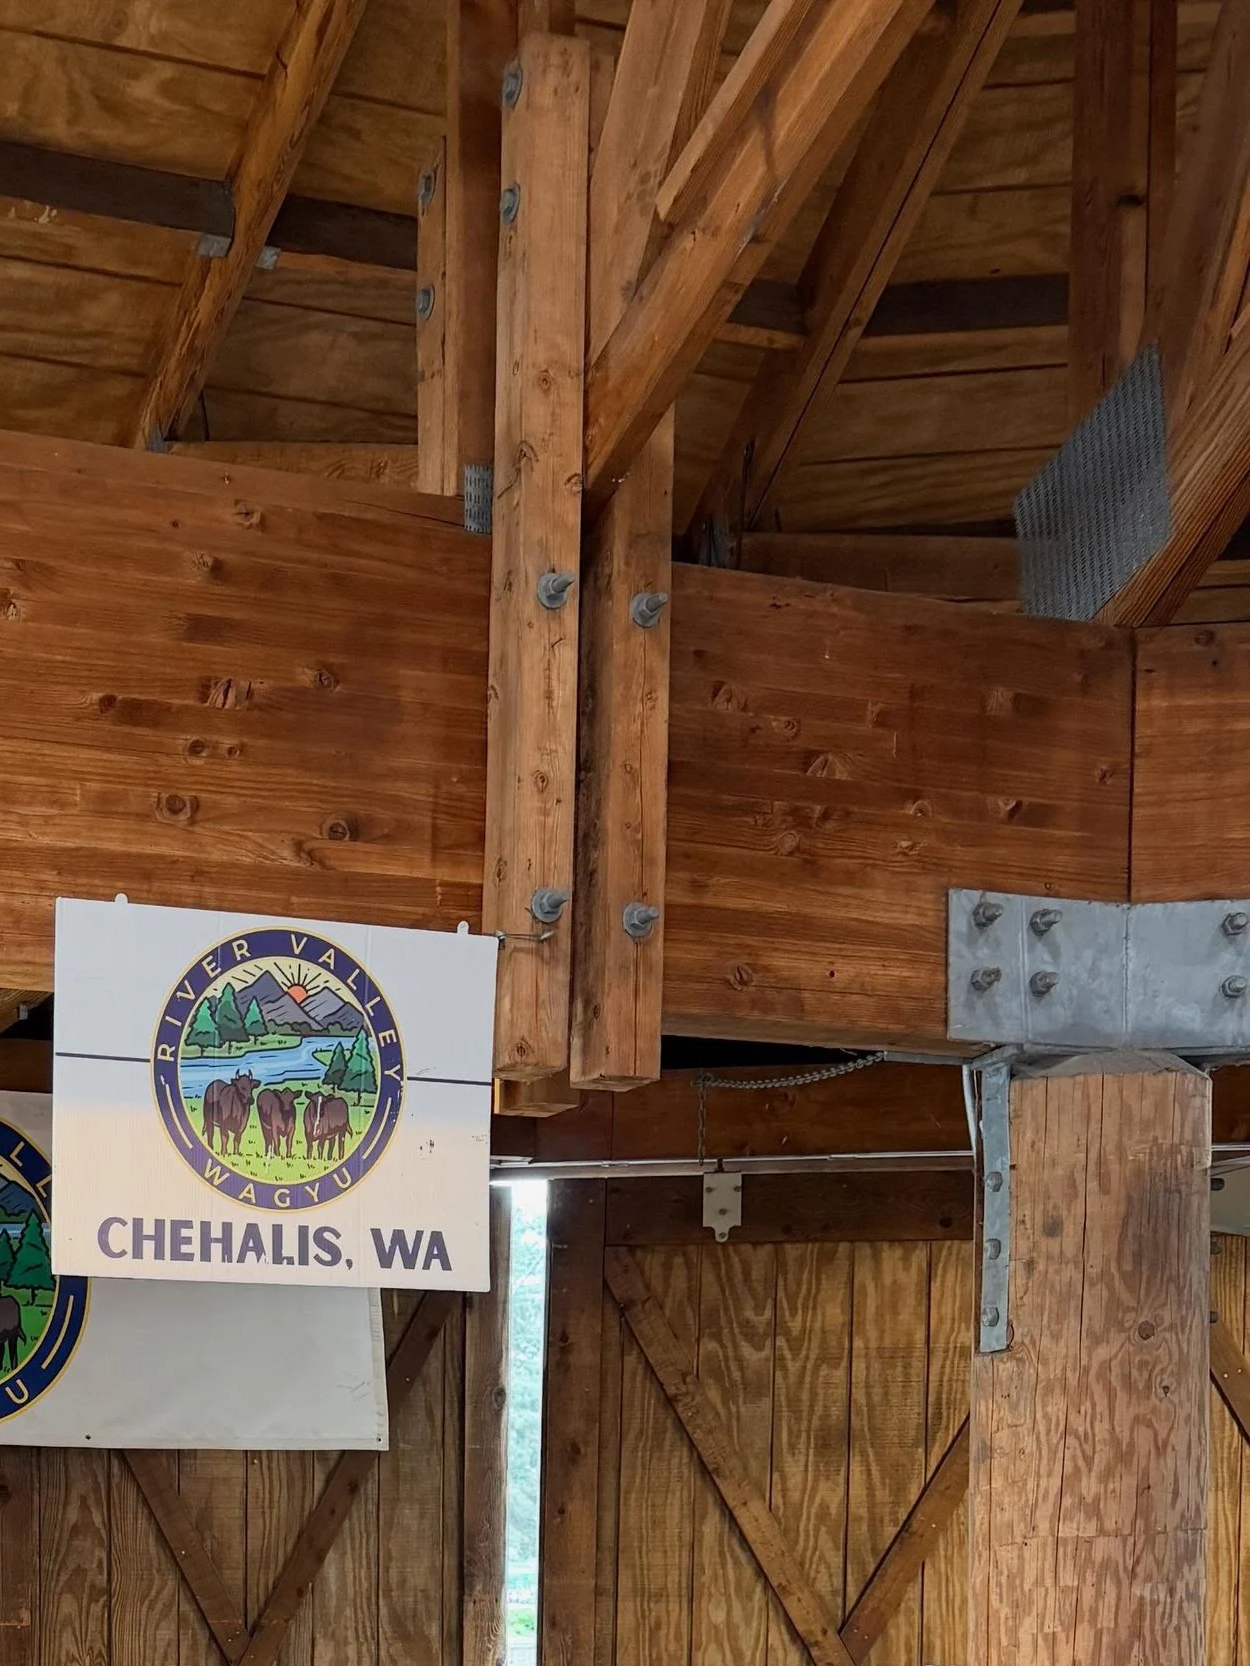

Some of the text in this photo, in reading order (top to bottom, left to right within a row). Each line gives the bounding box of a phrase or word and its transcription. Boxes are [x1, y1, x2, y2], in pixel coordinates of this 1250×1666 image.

[157, 933, 403, 1081] RIVER VALLEY
[200, 1158, 354, 1209] WAGYU
[96, 1215, 454, 1272] CHEHALIS, WA
